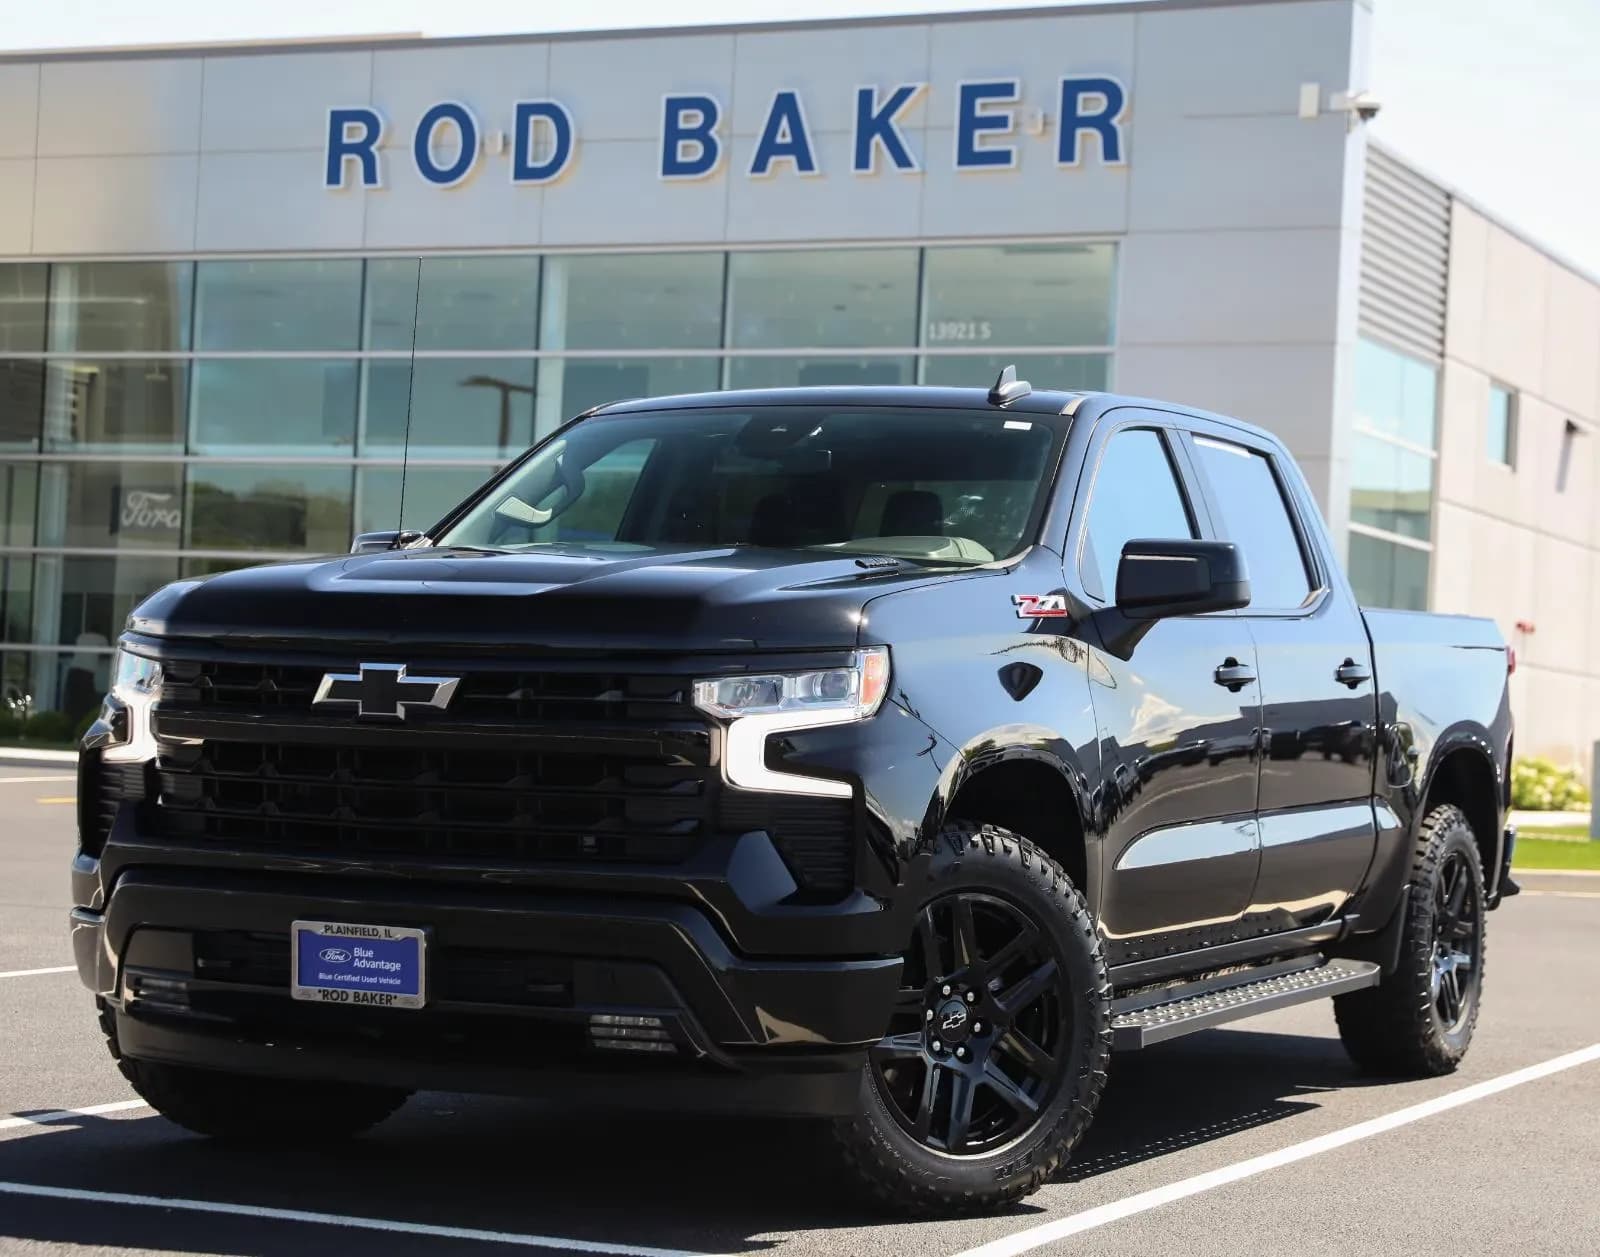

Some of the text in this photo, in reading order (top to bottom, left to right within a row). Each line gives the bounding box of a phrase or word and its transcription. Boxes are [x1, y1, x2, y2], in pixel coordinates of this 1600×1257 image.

[325, 73, 1129, 188] ROD BAKER
[1011, 594, 1068, 618] Z71
[323, 924, 392, 938] PLAINFIELD, IL
[325, 949, 346, 961] Ford
[353, 947, 374, 958] Blue
[353, 958, 402, 972] Advantage
[318, 972, 401, 985] Blue Certified Used Vehicle
